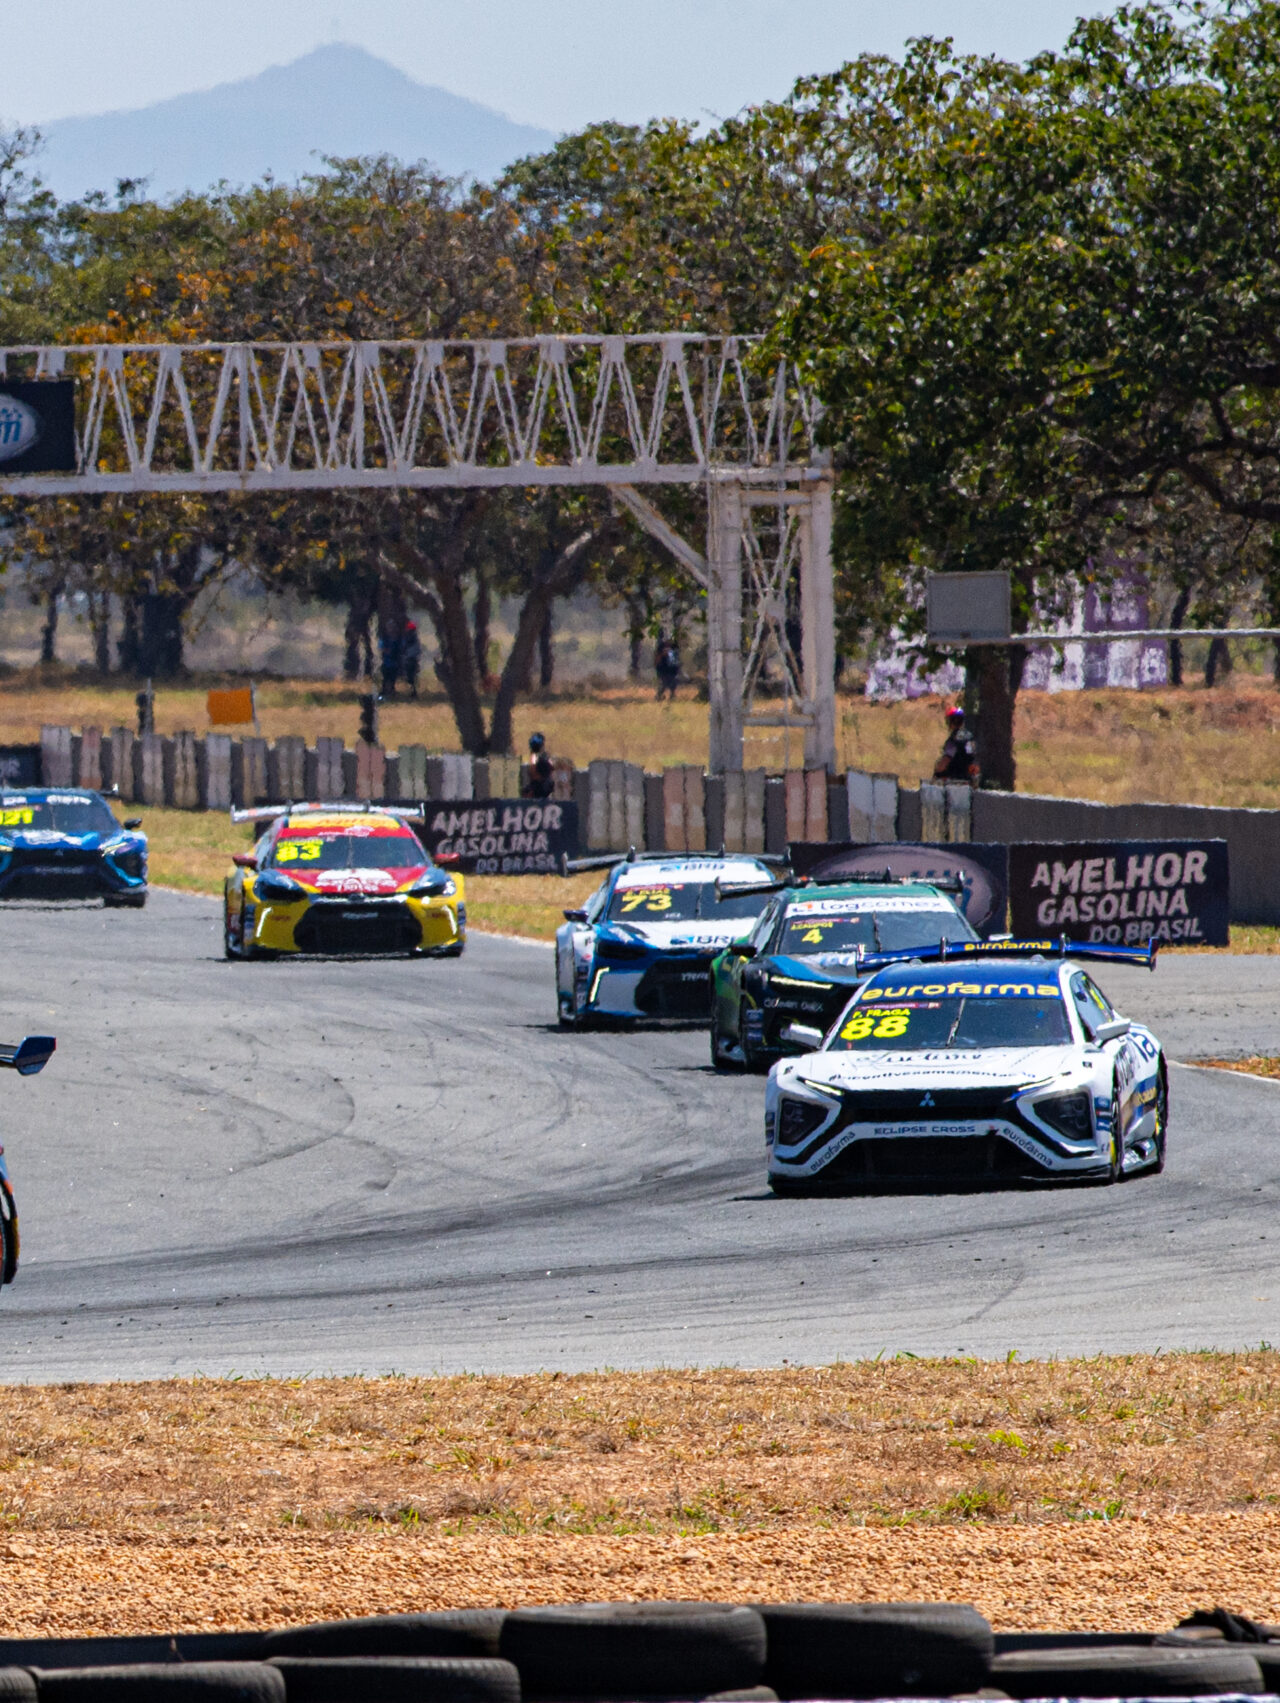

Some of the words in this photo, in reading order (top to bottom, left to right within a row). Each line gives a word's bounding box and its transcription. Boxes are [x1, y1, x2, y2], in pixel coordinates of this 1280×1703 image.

[436, 831, 549, 857] GASOLINA
[476, 858, 499, 875] DO
[620, 894, 672, 912] 73
[1037, 888, 1189, 926] GASOLINA
[802, 928, 823, 944] 4
[1088, 924, 1121, 944] DO
[1124, 917, 1203, 942] BRASIL
[964, 939, 1052, 951] eurofarma
[861, 981, 1060, 1001] eurofarma
[866, 1008, 912, 1018] FRAGA
[840, 1016, 910, 1040] 88
[874, 1125, 927, 1135] ECLIPSE
[931, 1125, 975, 1134] CROSS
[809, 1130, 857, 1172] eurofarma
[1003, 1127, 1053, 1167] eurofarma
